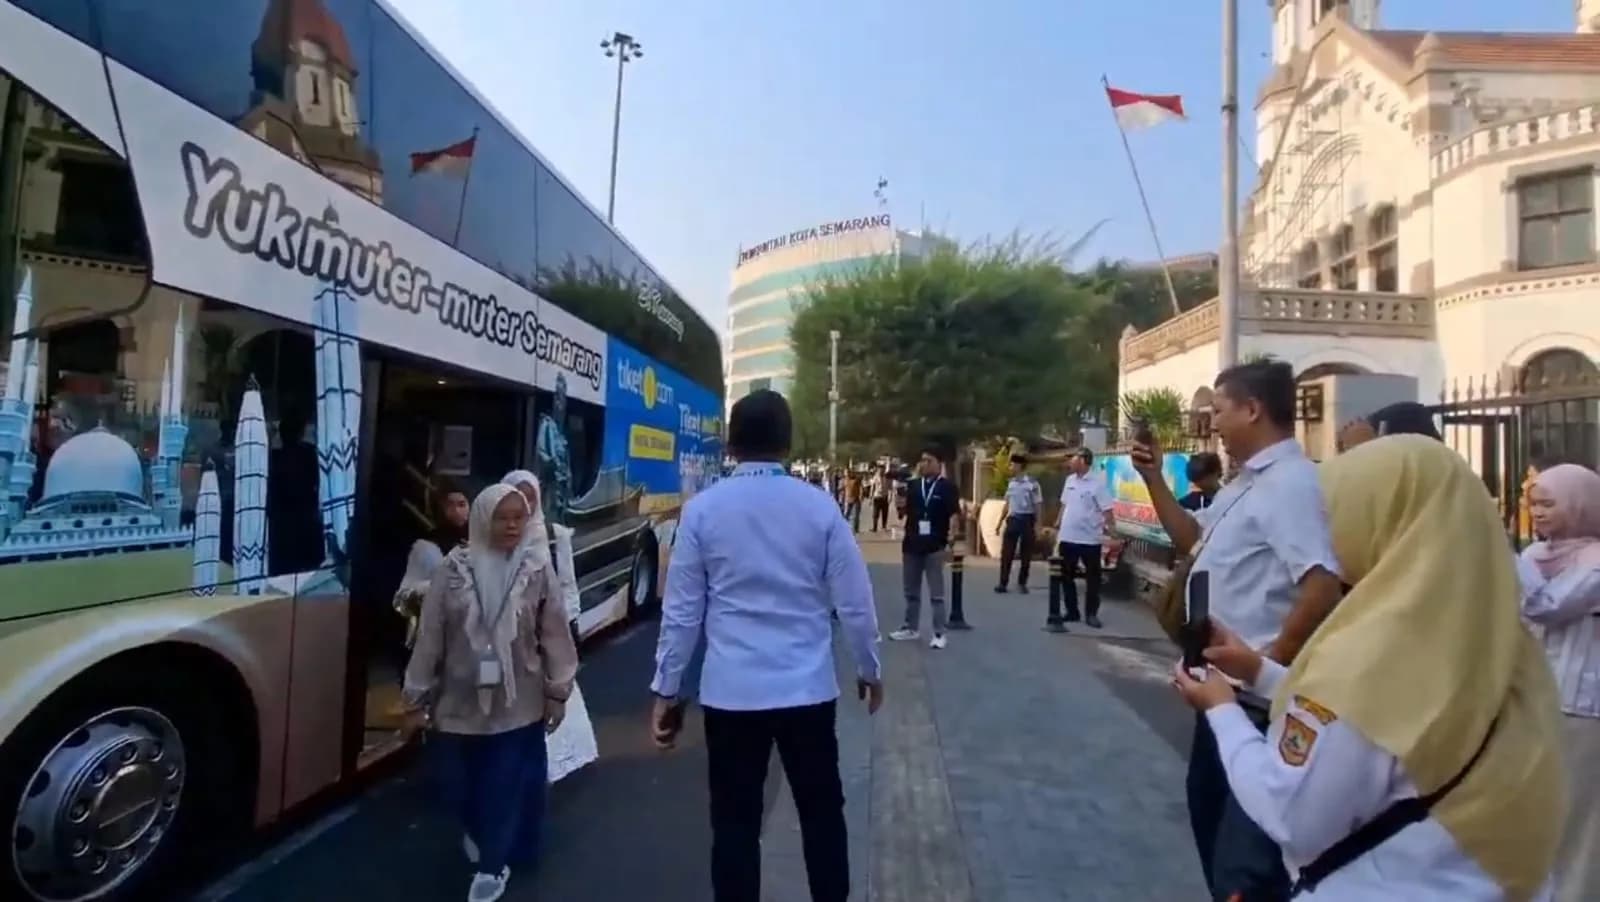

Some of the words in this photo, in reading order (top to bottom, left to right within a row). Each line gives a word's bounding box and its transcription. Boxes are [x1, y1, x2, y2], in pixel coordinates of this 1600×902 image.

[180, 141, 301, 269] Yuk
[298, 216, 521, 347] muter-muter
[521, 311, 602, 390] Semarang
[789, 227, 818, 245] KOTA
[819, 214, 891, 236] SEMARANG
